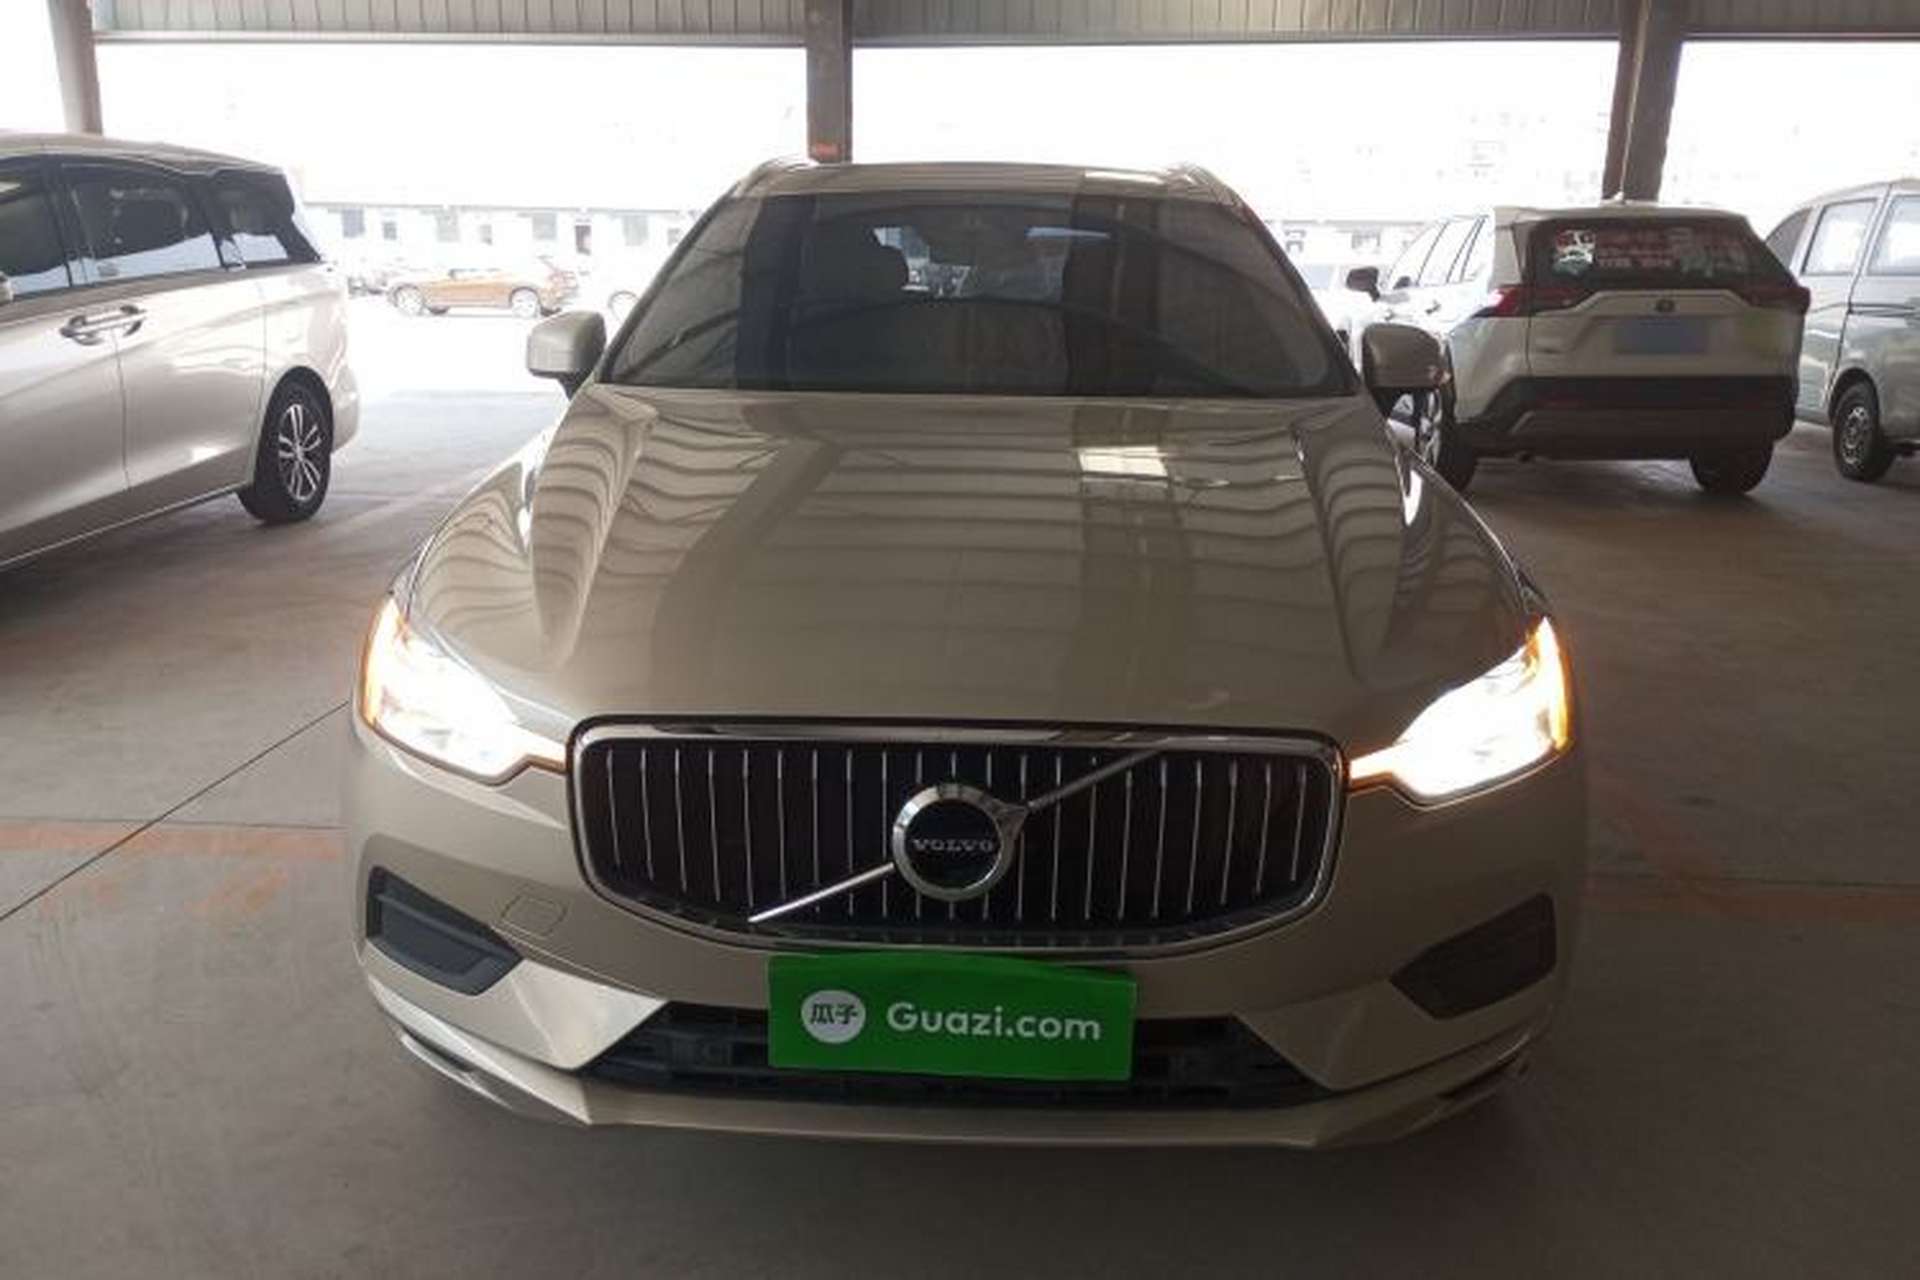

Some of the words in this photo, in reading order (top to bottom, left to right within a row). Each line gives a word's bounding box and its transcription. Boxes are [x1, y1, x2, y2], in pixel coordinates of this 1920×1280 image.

[912, 839, 993, 851] VOLVO
[810, 1003, 858, 1025] 瓜子
[886, 1002, 1101, 1041] Guazi.com
